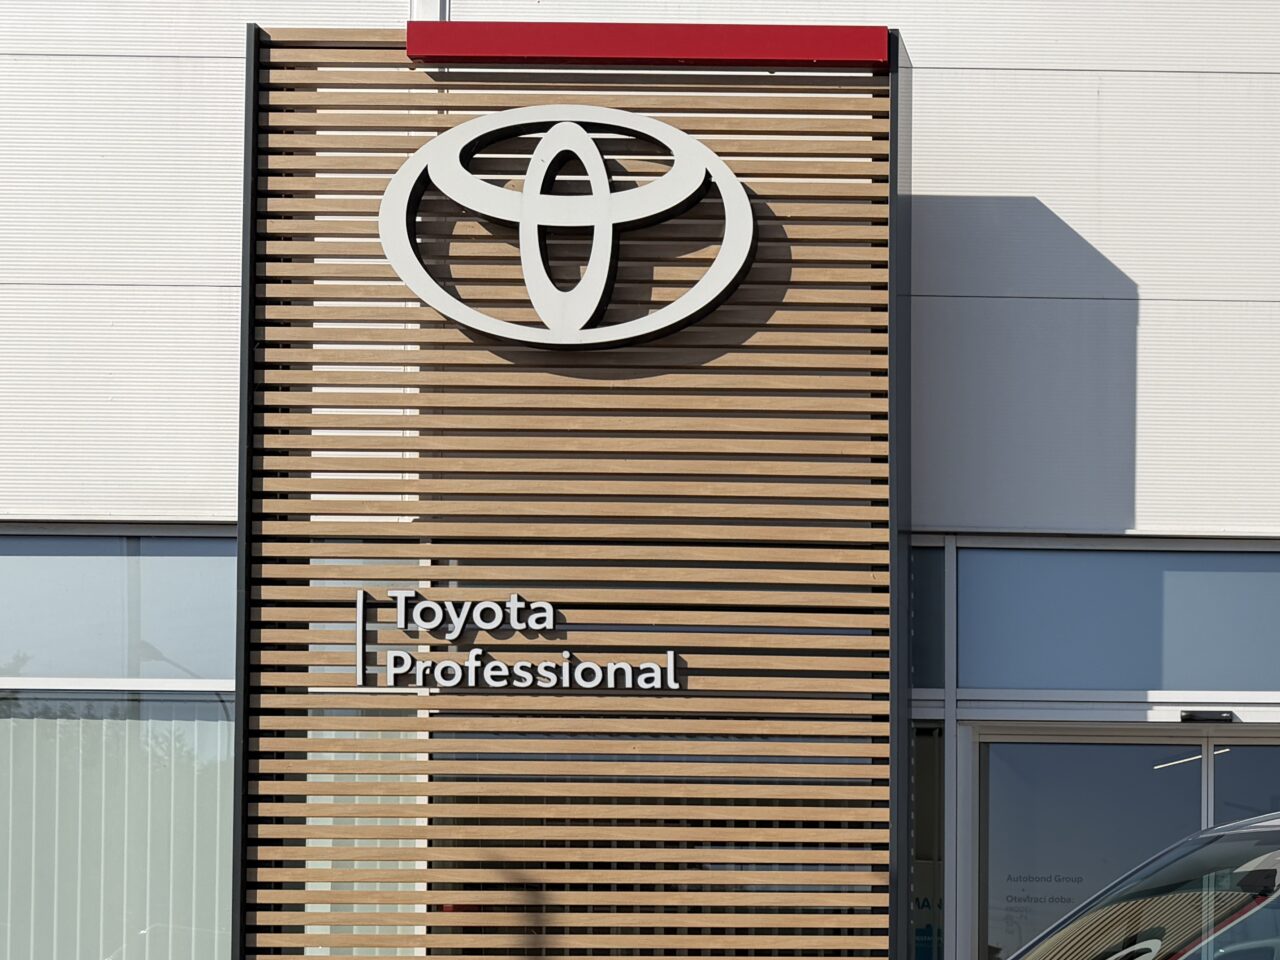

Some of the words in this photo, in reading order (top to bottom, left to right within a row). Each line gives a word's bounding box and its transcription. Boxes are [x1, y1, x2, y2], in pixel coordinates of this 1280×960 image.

[386, 589, 555, 641] Toyota
[385, 648, 681, 689] Professional
[1006, 874, 1052, 883] Autobond
[1054, 874, 1084, 885] Group
